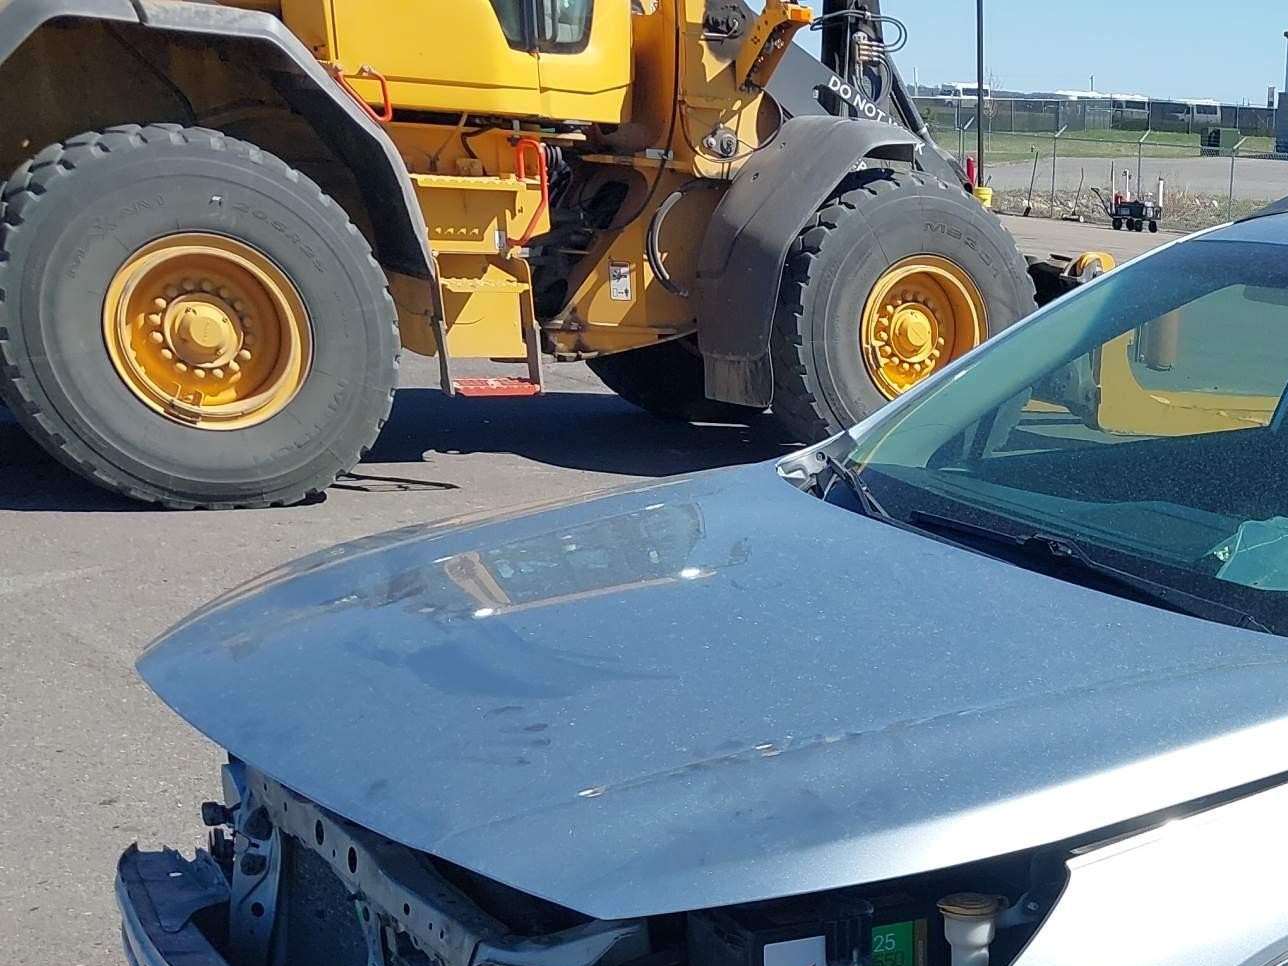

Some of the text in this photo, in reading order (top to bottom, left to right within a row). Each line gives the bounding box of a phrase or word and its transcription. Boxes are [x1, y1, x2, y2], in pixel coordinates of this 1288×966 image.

[828, 75, 886, 121] DO NOT
[873, 933, 896, 952] 25
